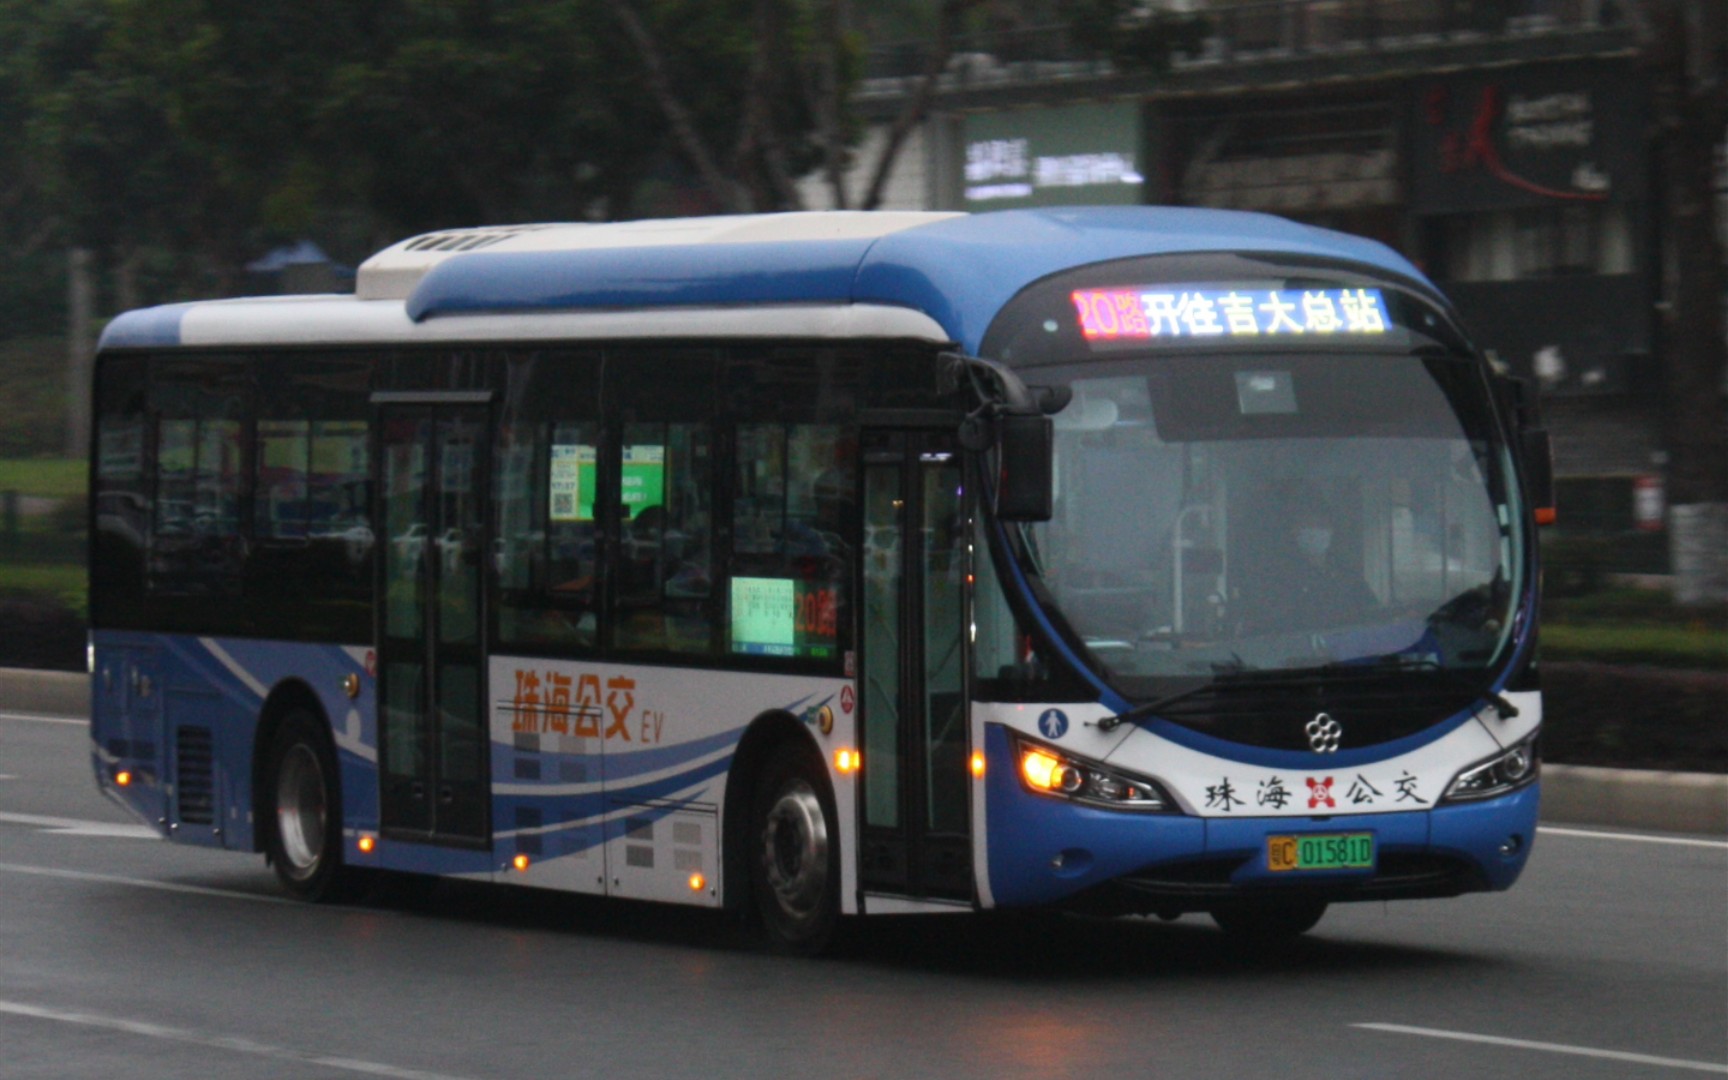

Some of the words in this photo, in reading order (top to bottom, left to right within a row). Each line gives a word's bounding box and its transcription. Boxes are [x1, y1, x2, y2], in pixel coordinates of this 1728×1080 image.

[512, 669, 636, 742] 珠海公交
[640, 709, 664, 743] EV
